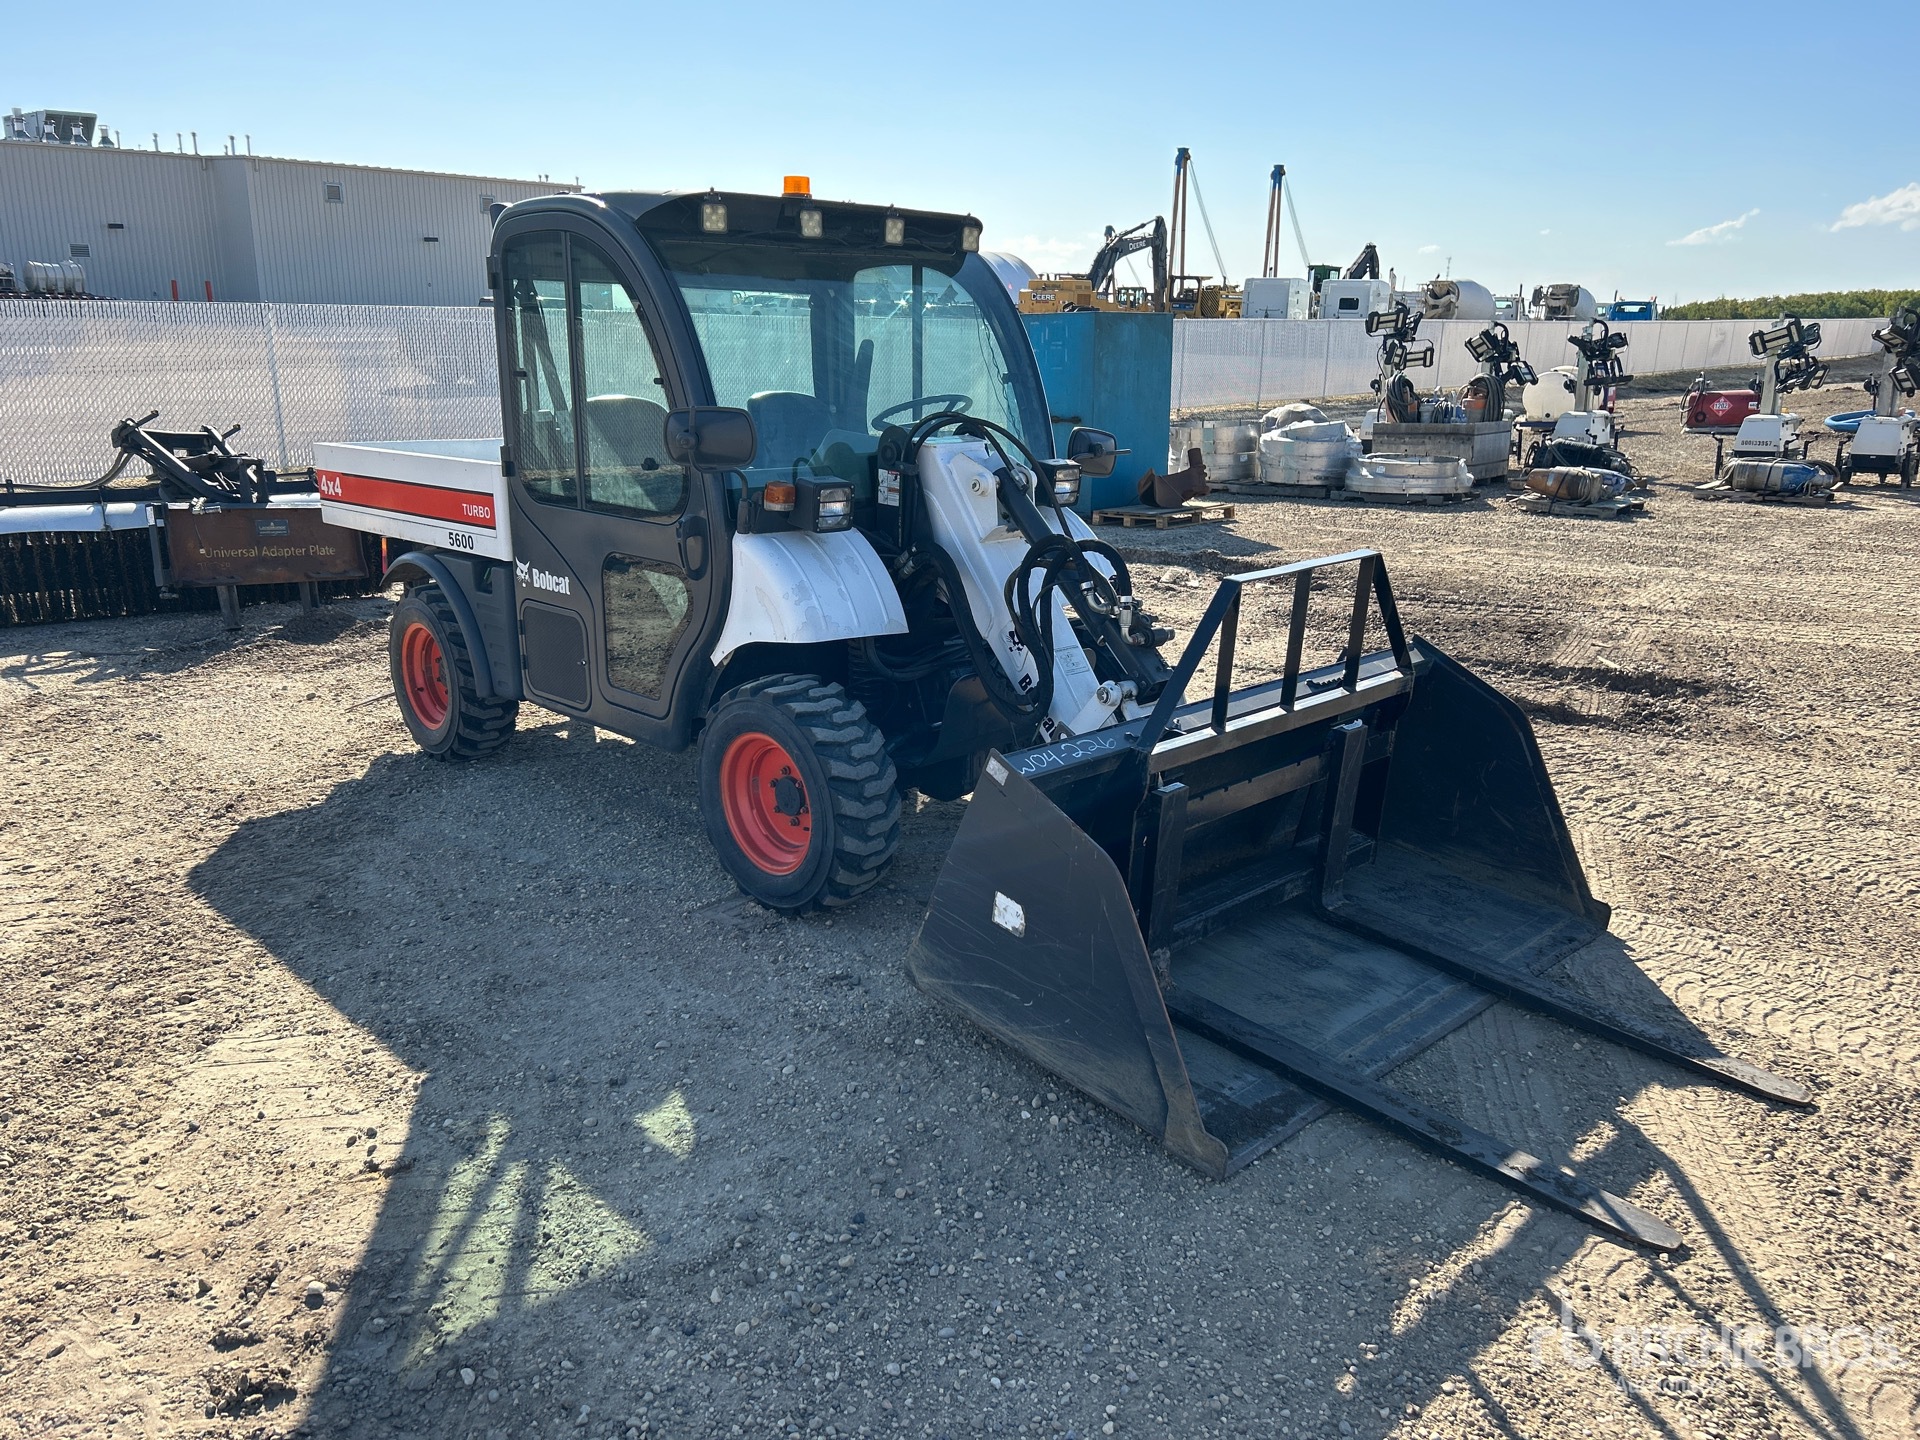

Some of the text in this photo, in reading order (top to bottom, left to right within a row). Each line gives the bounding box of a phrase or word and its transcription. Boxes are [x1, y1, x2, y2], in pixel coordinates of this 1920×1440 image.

[1129, 240, 1146, 250] DEERE
[1032, 293, 1056, 301] DEERE
[320, 475, 342, 497] 4x4
[462, 503, 491, 519] TURBO
[448, 532, 474, 550] 5600
[204, 544, 336, 558] Universal Adapter Plate
[532, 568, 571, 595] Bobcat
